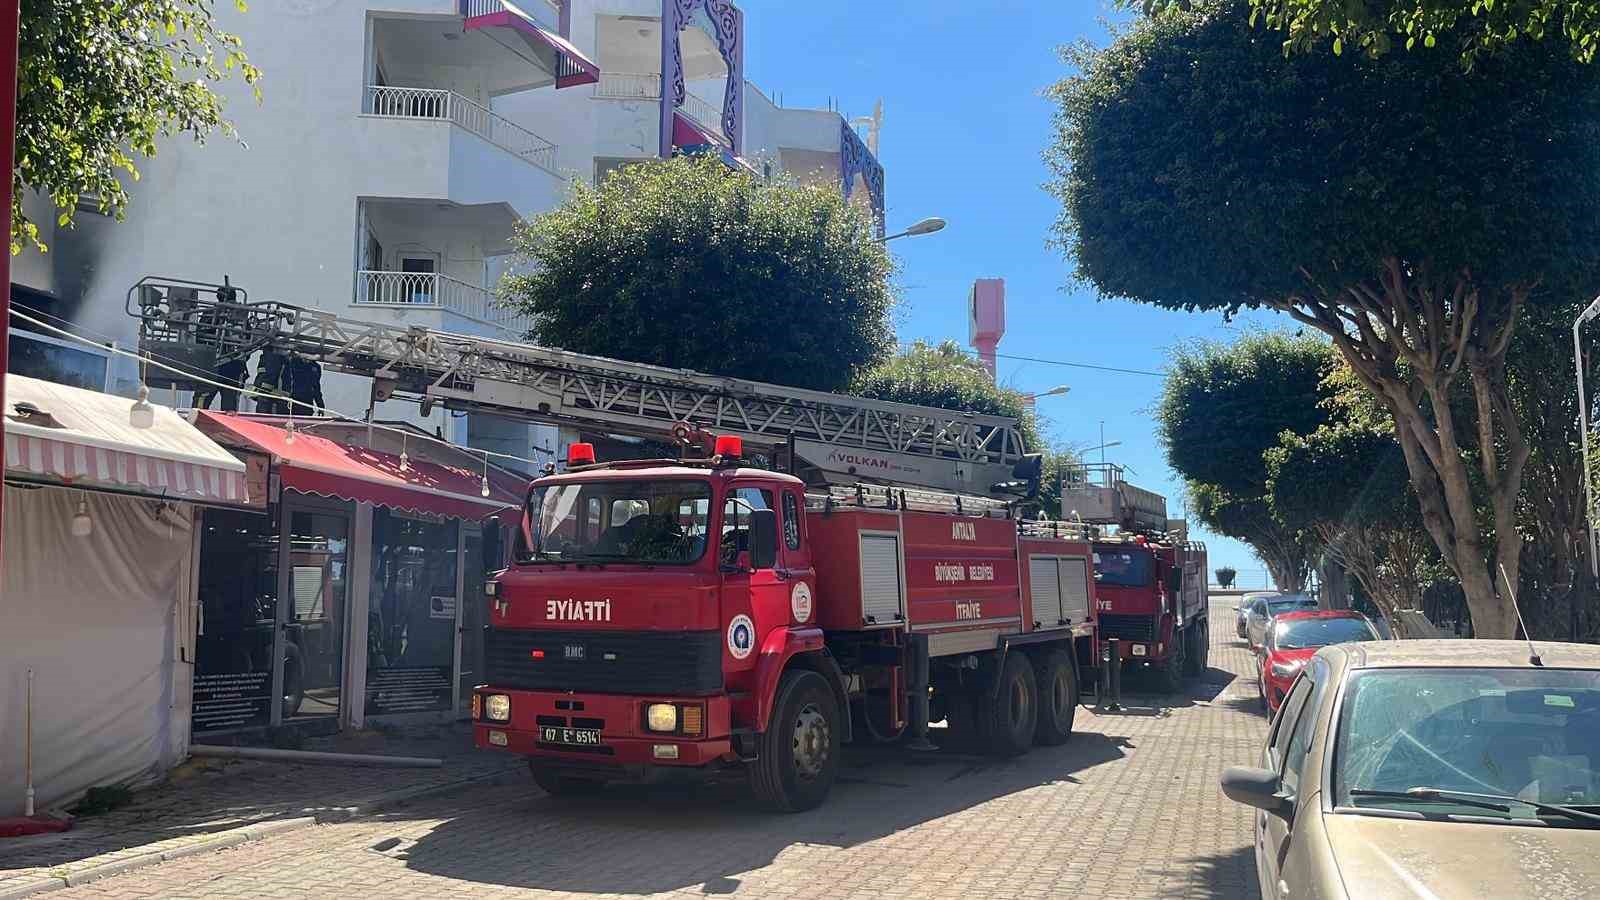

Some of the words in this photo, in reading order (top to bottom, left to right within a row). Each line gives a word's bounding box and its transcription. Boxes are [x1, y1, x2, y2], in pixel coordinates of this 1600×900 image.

[839, 454, 888, 469] VOLKAN
[952, 521, 976, 540] ANTALYA
[546, 728, 556, 741] 07
